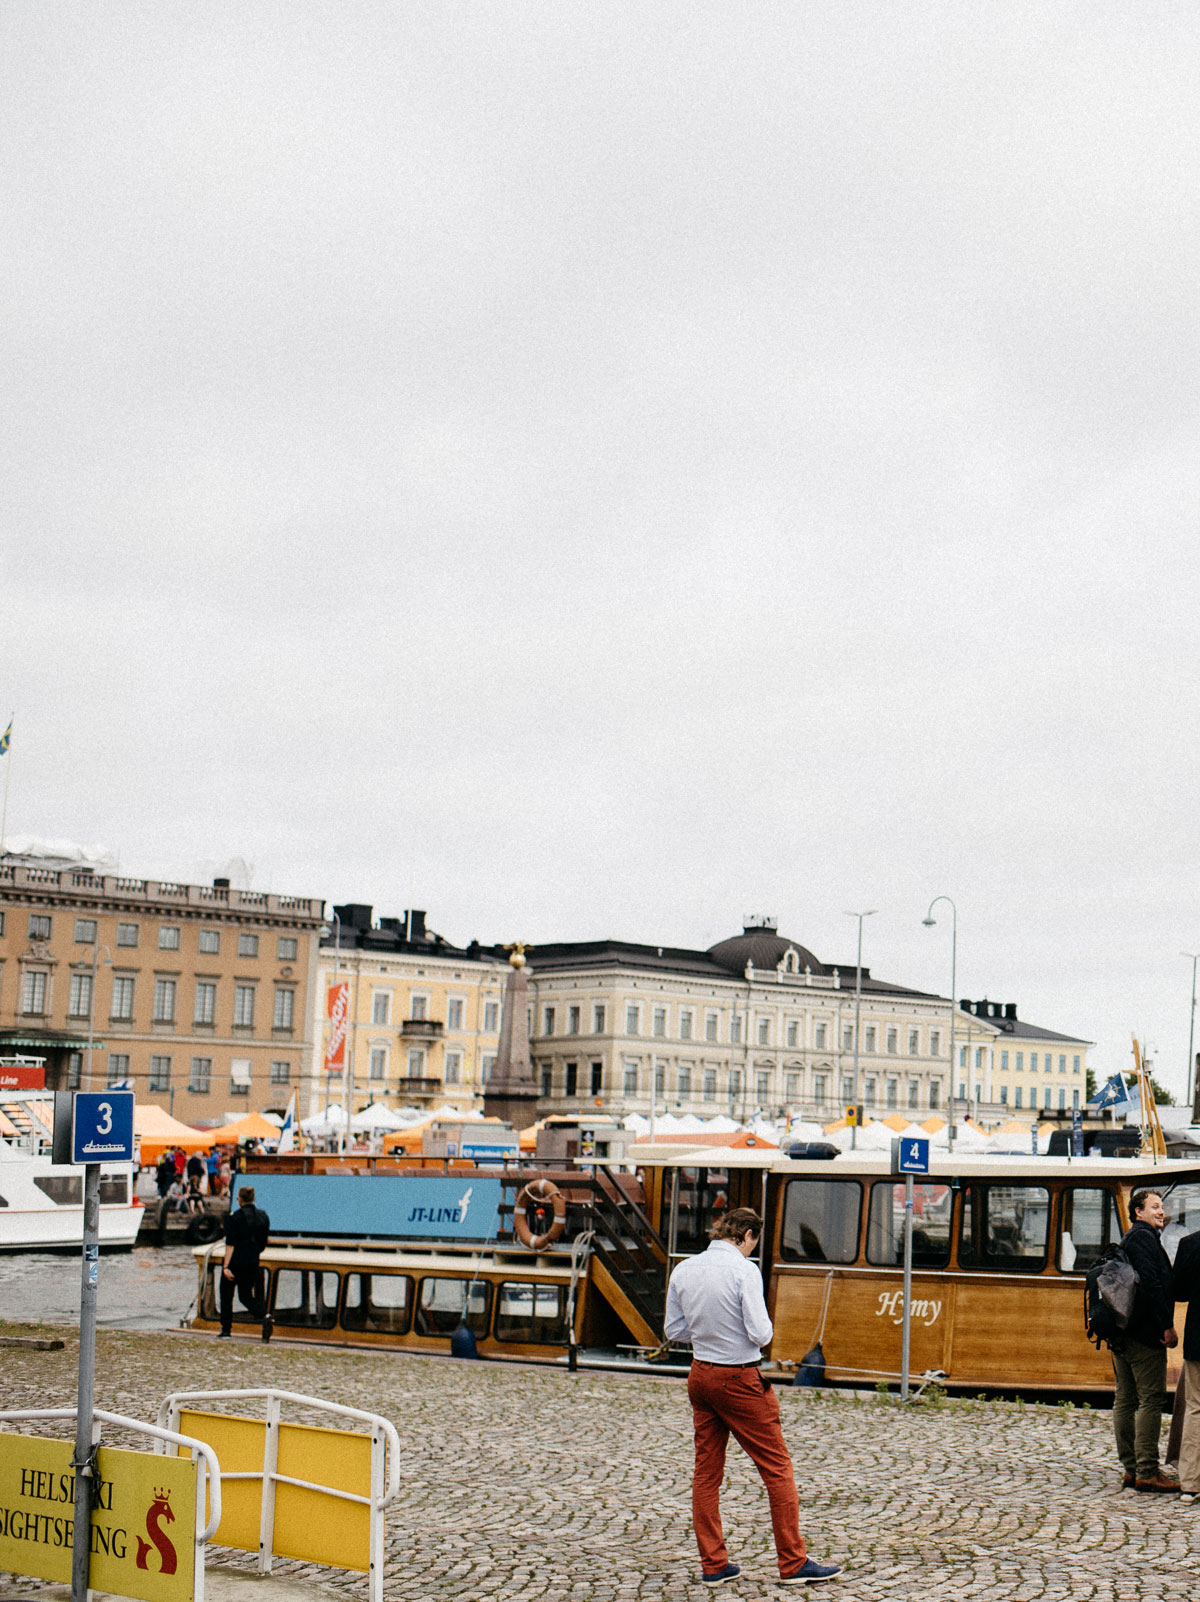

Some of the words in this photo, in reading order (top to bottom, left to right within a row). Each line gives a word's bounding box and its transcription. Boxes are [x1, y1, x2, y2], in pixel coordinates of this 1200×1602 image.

[96, 1102, 113, 1135] 3
[909, 1142, 920, 1160] 4
[408, 1207, 461, 1223] JT-LINE
[20, 1468, 114, 1511] HELSIKI
[0, 1507, 127, 1559] IGHTSEING
